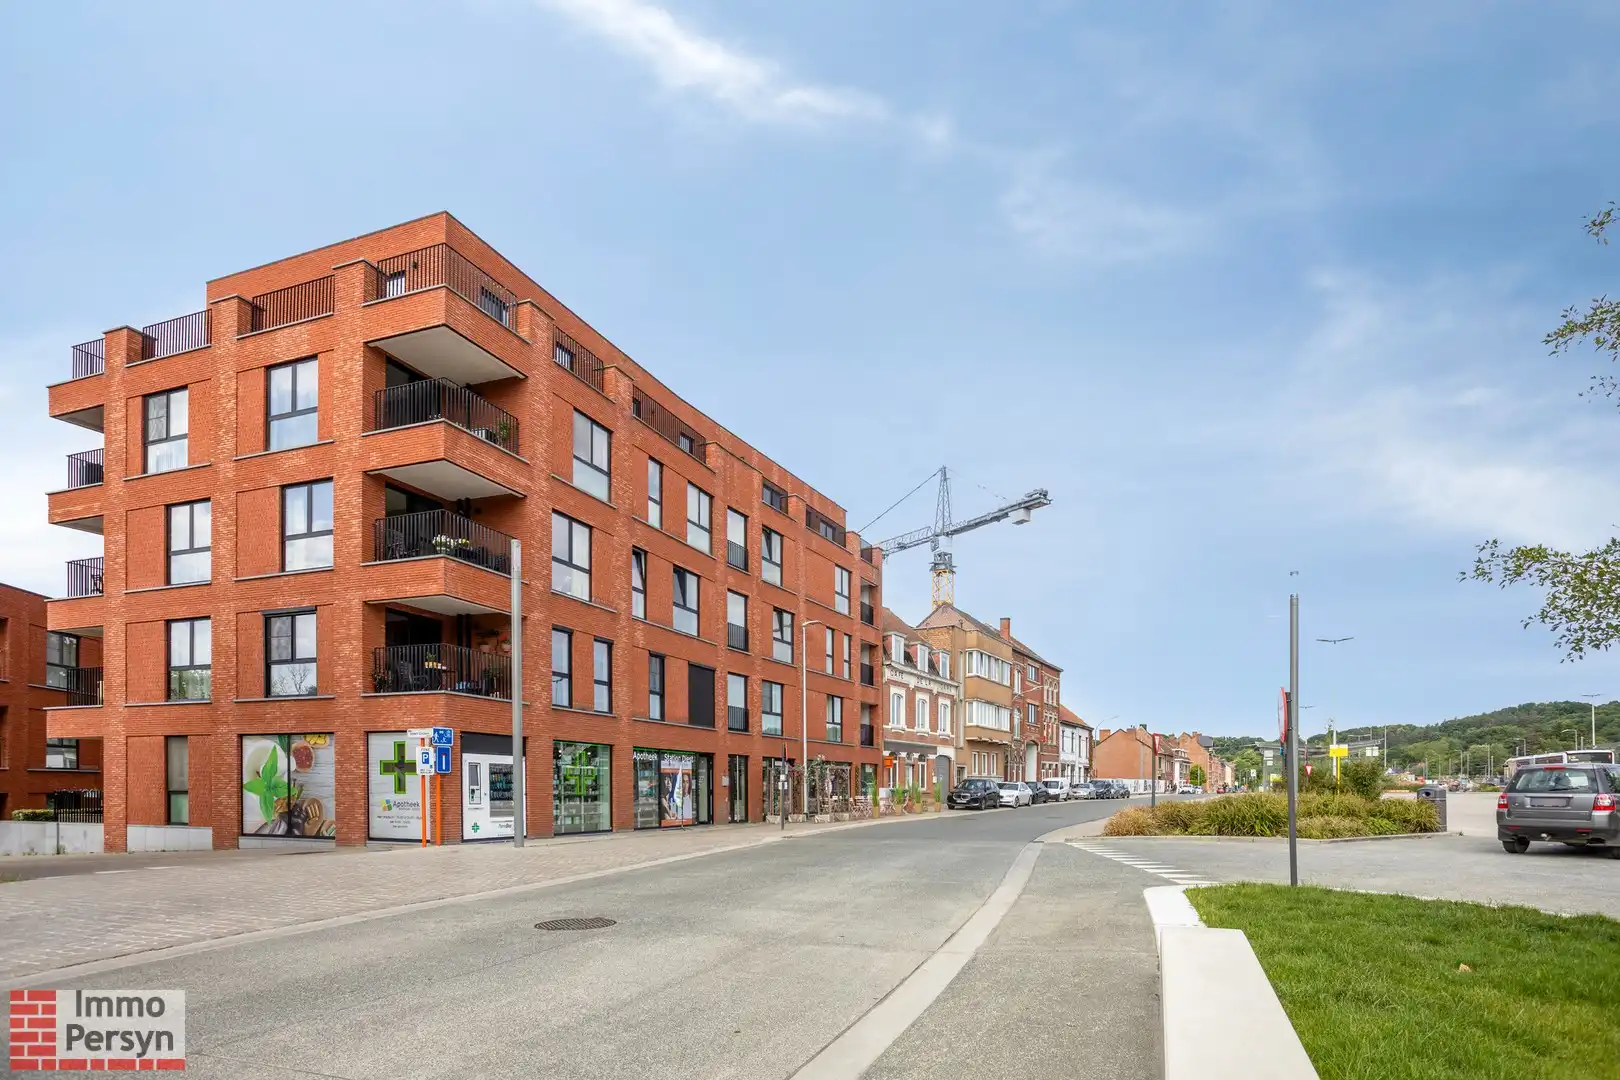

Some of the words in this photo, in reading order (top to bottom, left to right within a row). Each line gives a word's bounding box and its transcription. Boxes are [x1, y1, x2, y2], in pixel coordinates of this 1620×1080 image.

[633, 751, 658, 761] Apotheek
[664, 753, 681, 762] Station
[393, 800, 420, 809] Apotheek
